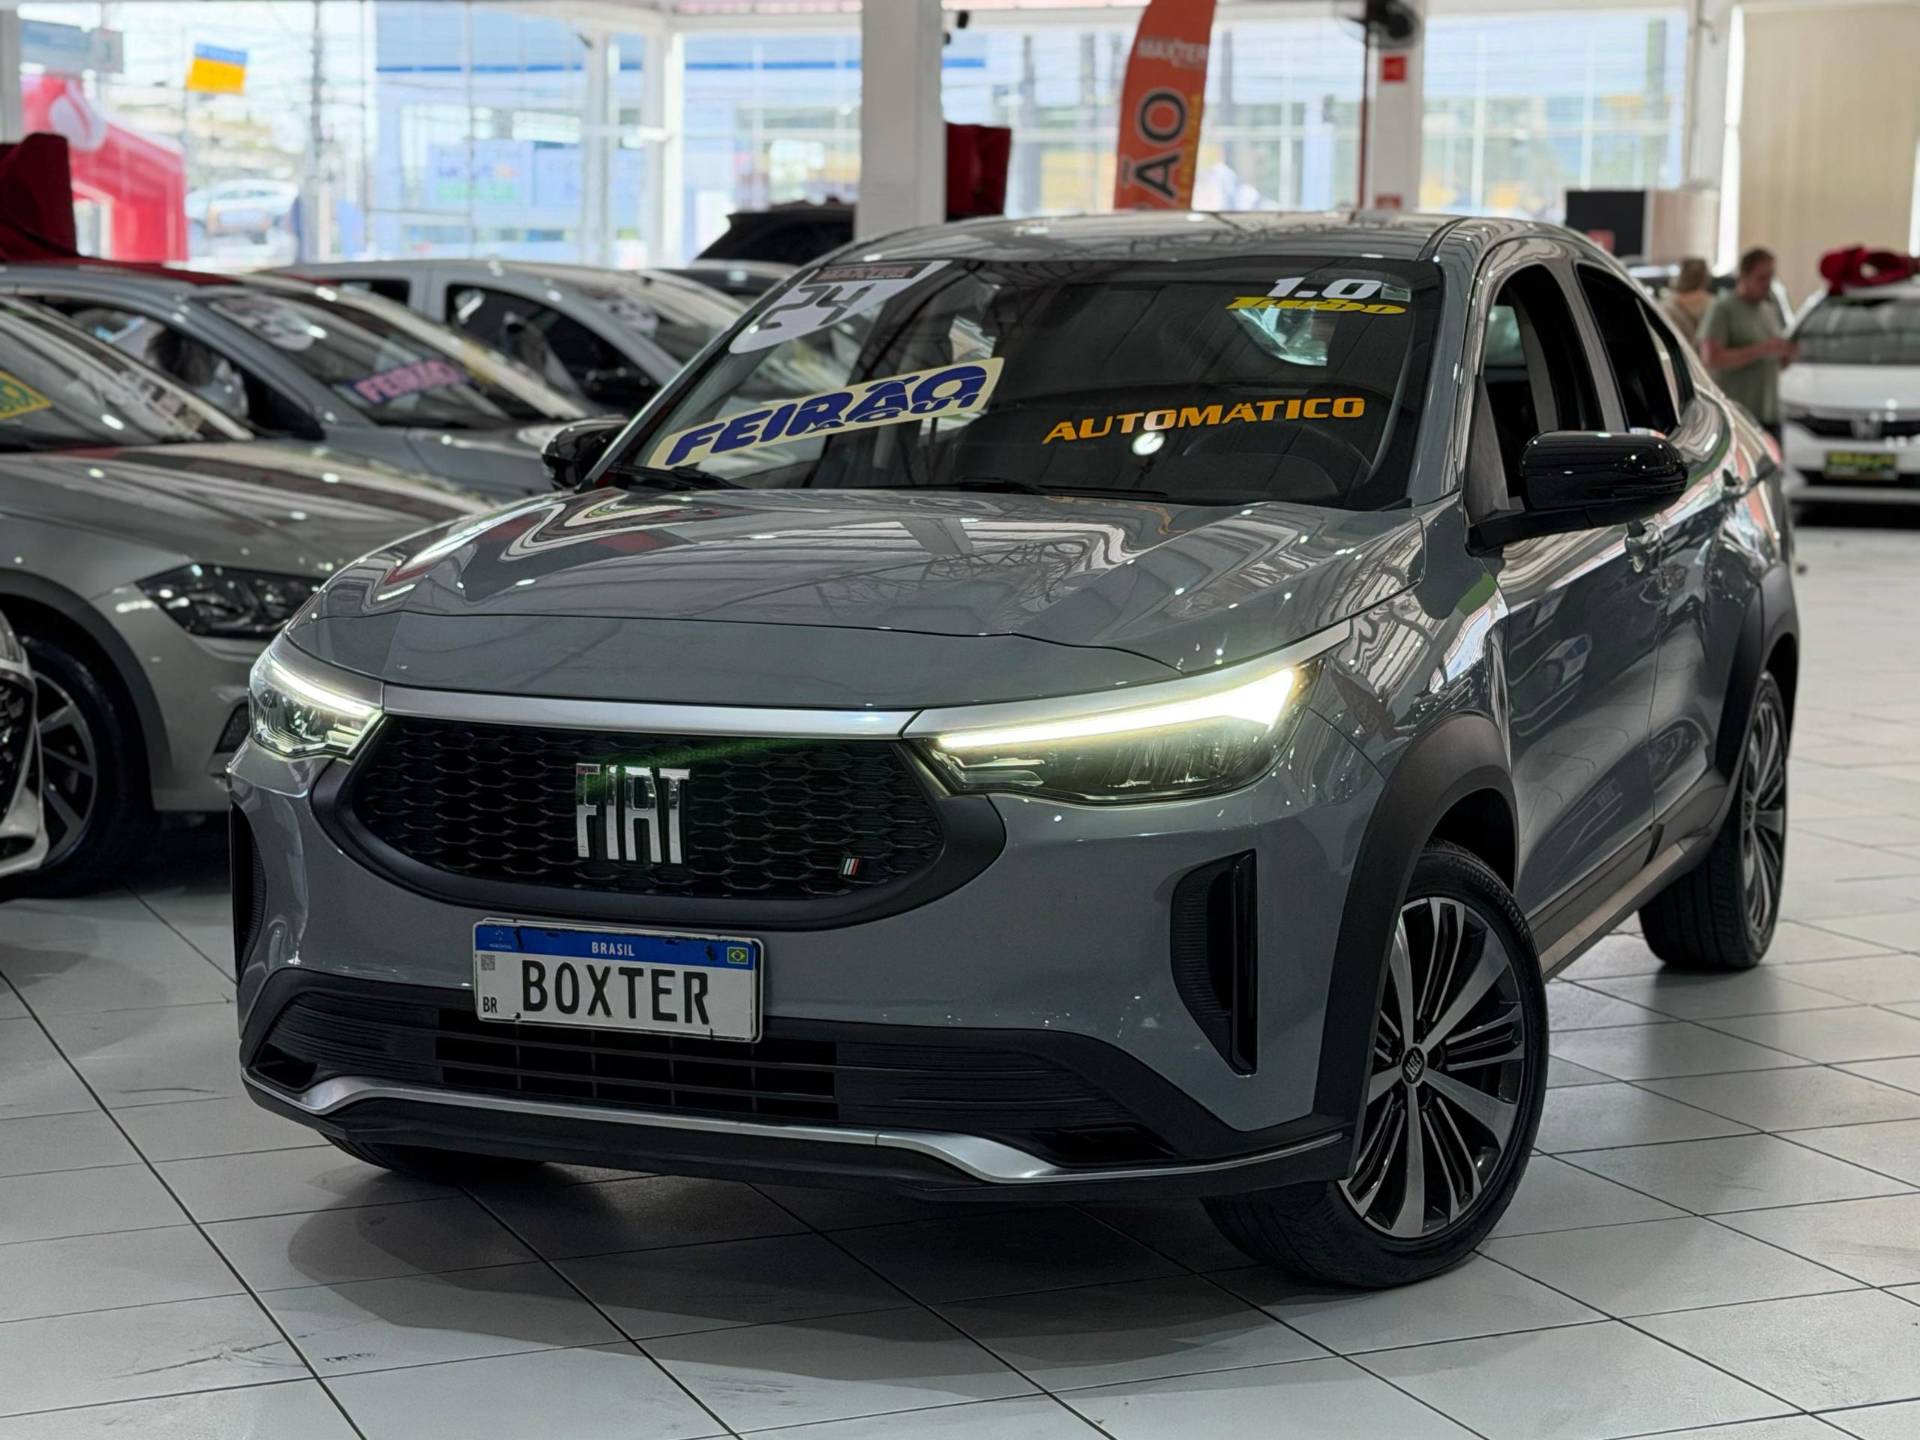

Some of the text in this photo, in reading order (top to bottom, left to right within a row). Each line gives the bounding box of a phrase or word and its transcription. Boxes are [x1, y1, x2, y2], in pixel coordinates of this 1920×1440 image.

[1122, 88, 1186, 209] ÃO
[1266, 277, 1382, 299] 1.0
[664, 366, 988, 466] FEIRÃO
[576, 763, 691, 864] FIAT
[591, 941, 635, 956] BRASIL
[482, 996, 498, 1014] BR
[521, 959, 710, 1025] BOXTER
